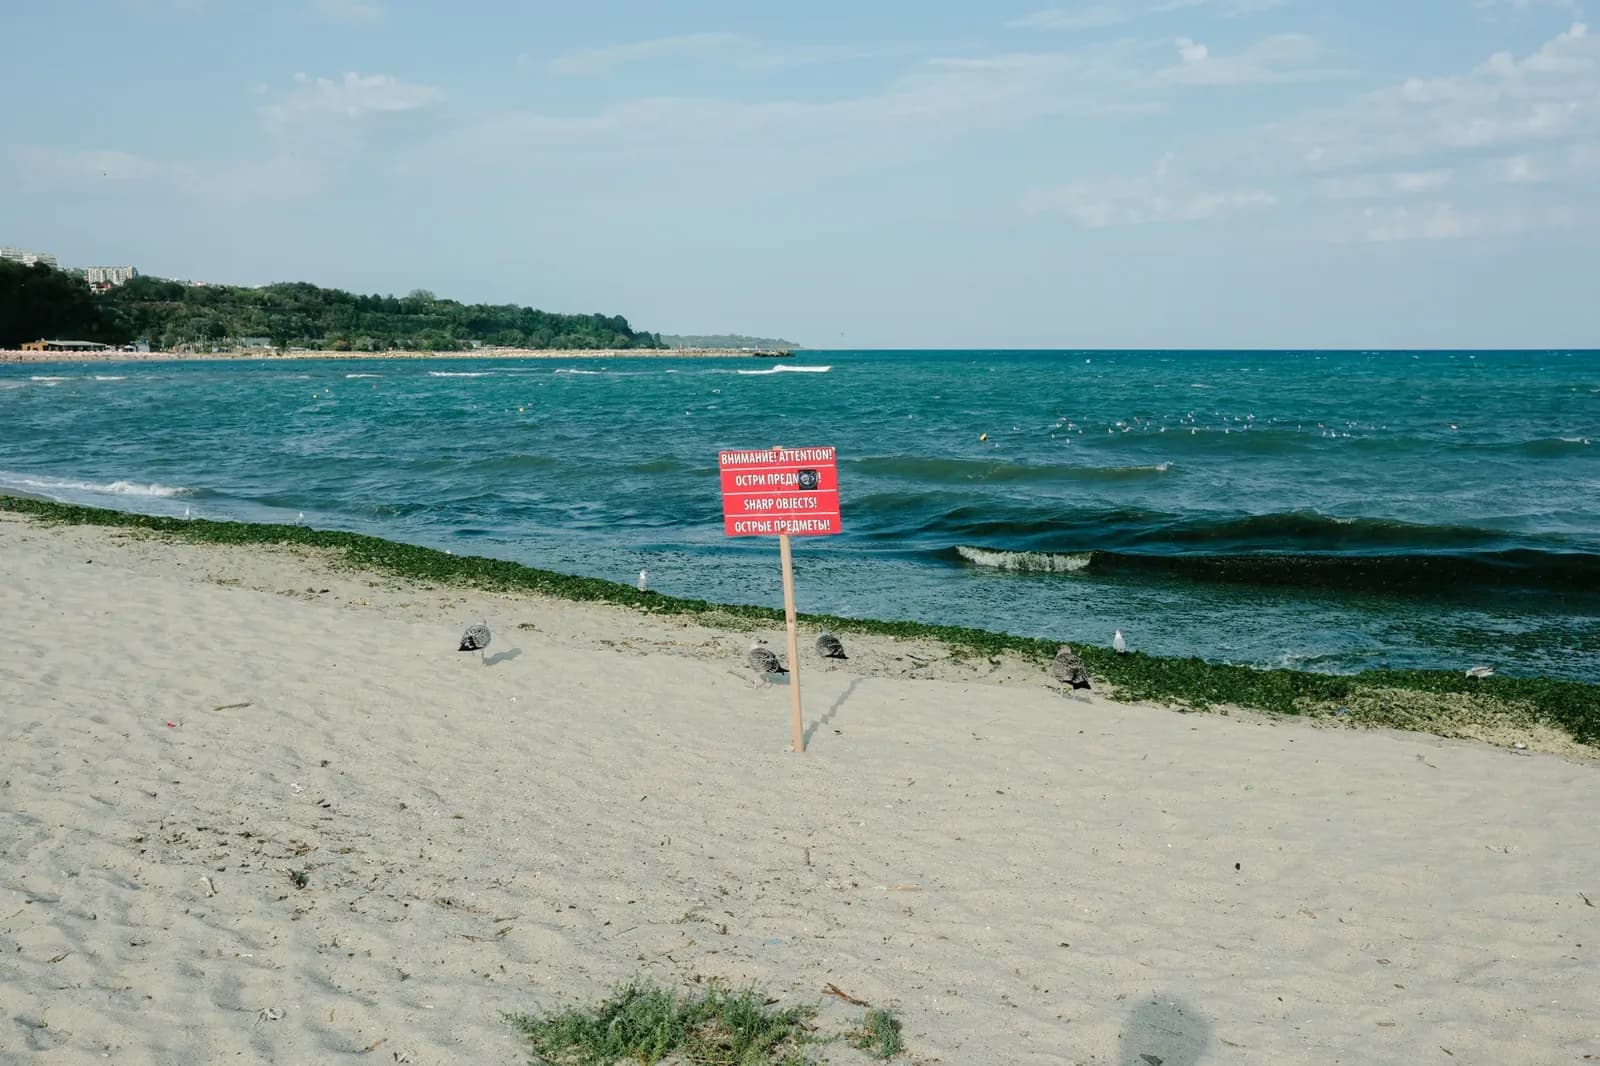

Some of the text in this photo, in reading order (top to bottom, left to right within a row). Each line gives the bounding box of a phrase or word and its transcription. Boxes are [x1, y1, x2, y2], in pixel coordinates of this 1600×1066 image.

[721, 449, 833, 465] ВНИМАНИЕ! ATTENTION!
[735, 472, 822, 487] ОСТРИ ПРЕДМ!
[743, 497, 817, 511] SHARP OBJECTS!
[735, 519, 831, 533] ОСТРЫЕ ПРЕДМЕТЫ!
